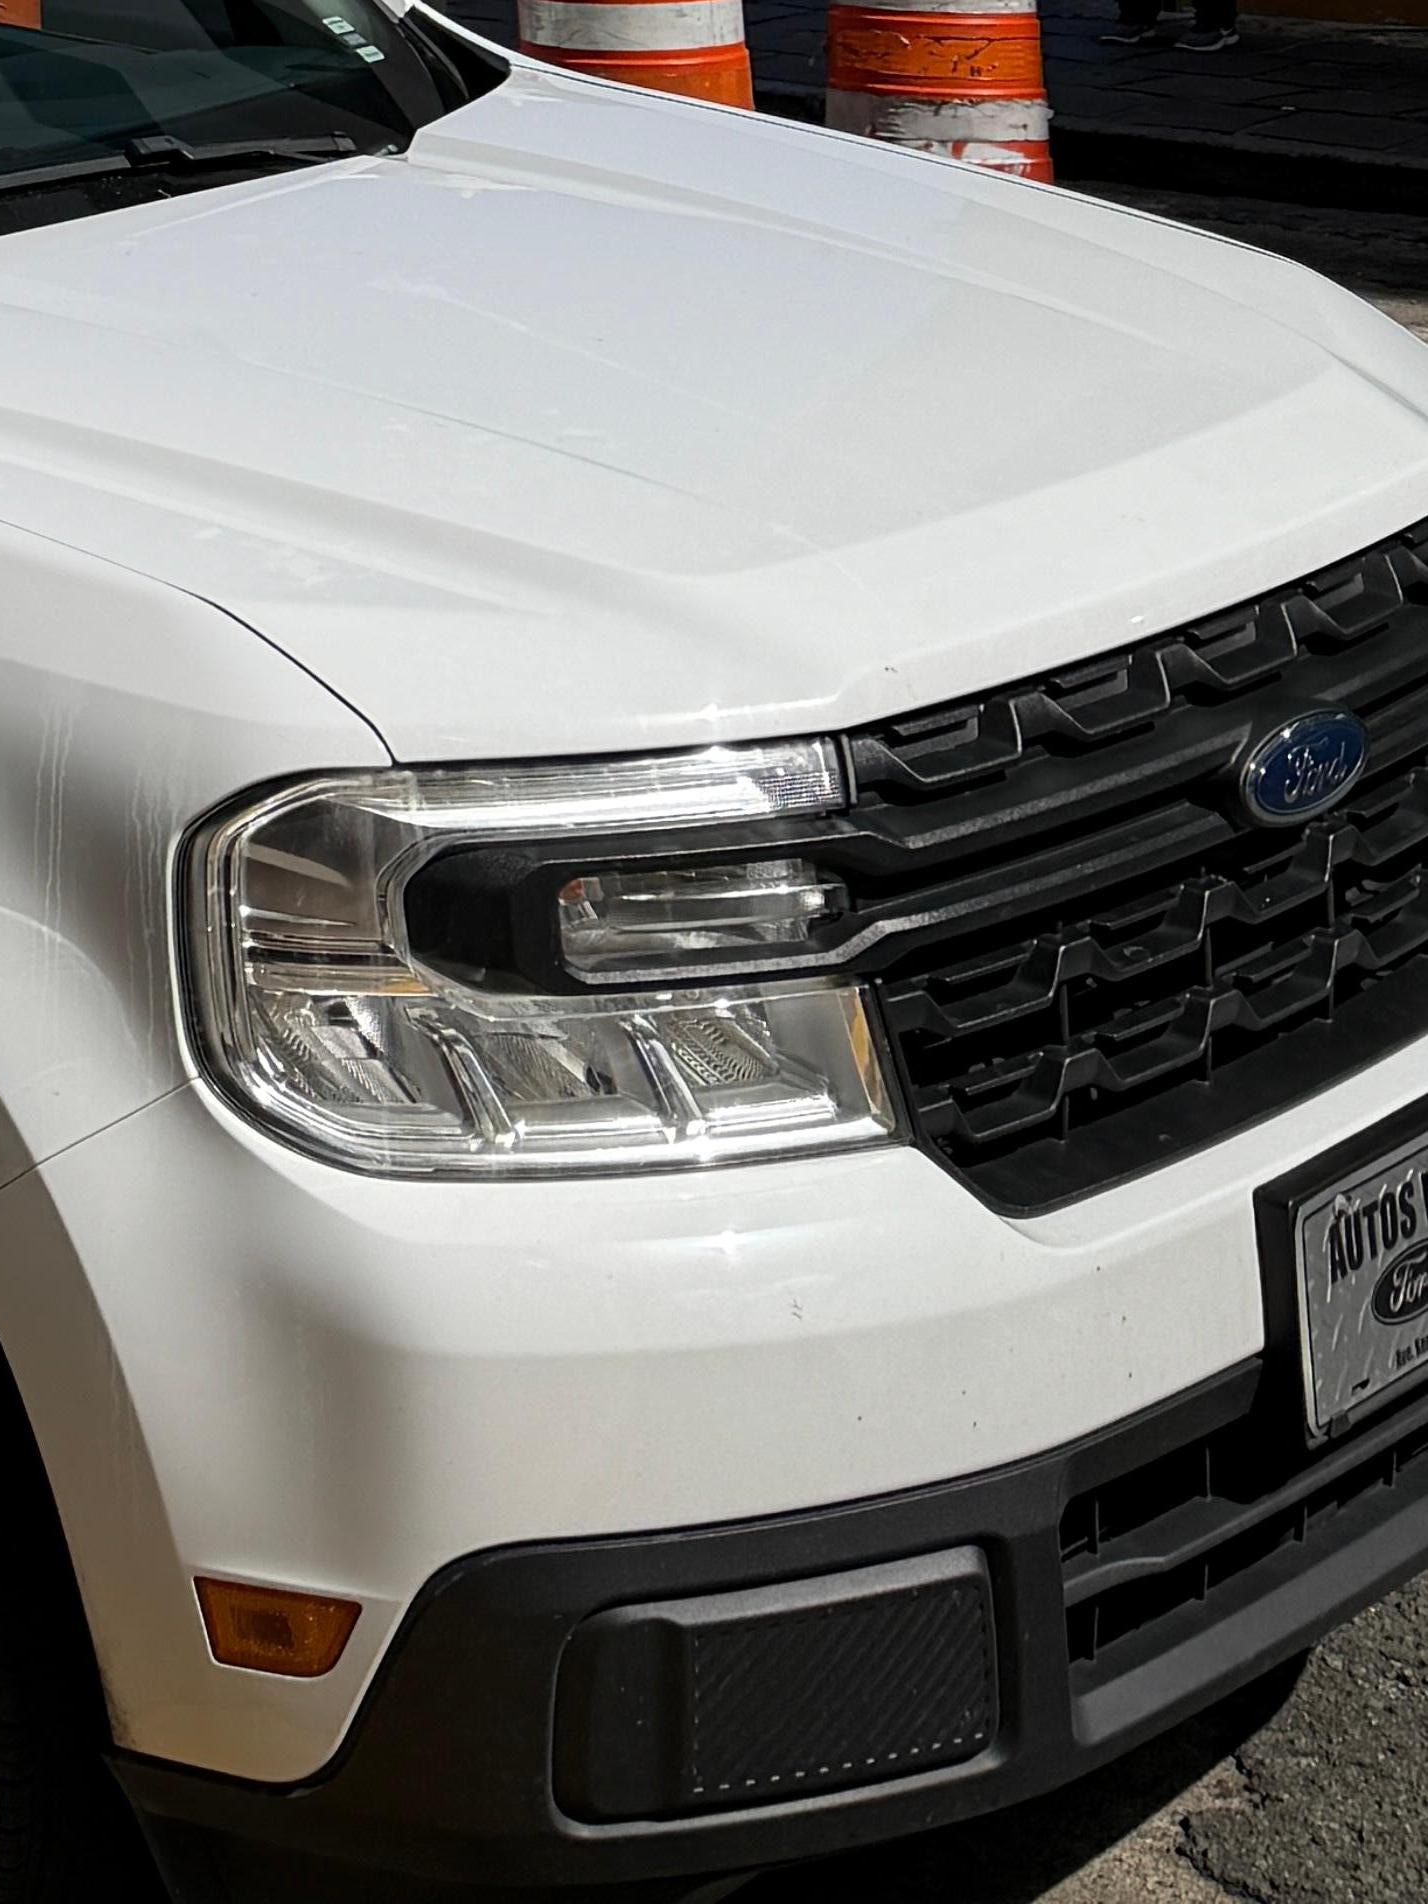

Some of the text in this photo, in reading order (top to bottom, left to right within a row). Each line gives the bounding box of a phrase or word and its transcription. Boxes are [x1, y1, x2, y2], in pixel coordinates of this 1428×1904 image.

[1284, 735, 1349, 804] Ford
[1329, 1180, 1417, 1284] AUTOS
[1390, 1252, 1428, 1315] For
